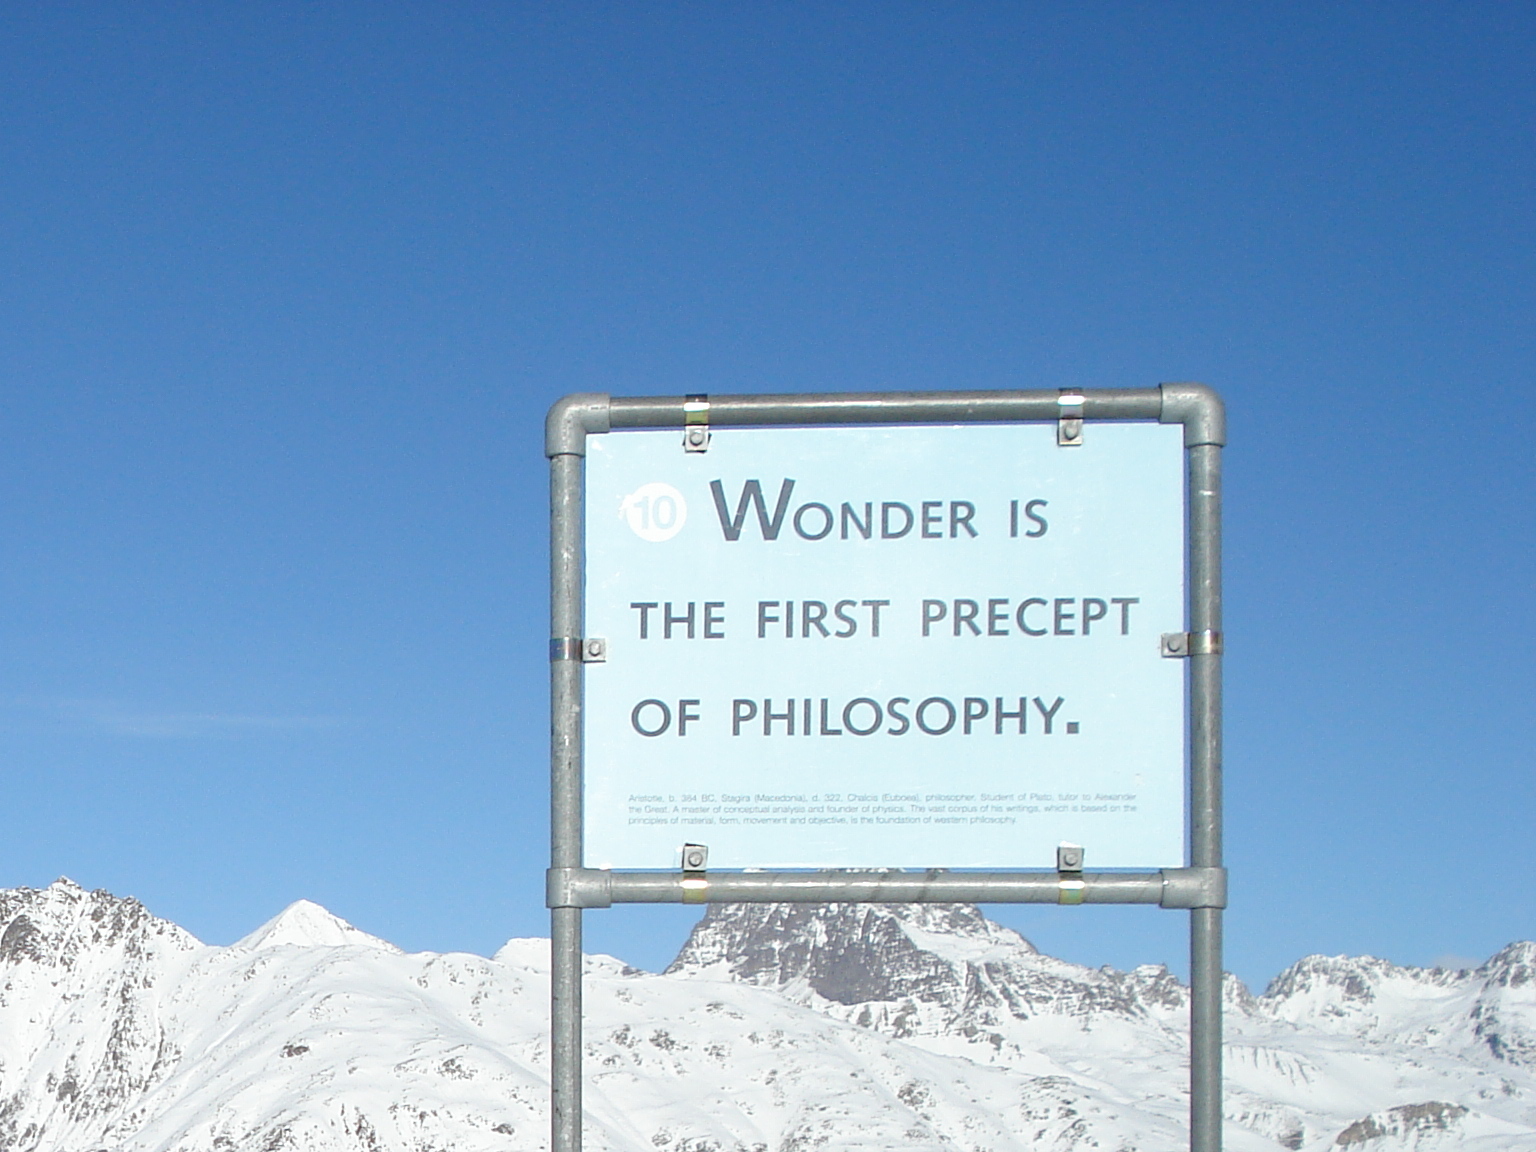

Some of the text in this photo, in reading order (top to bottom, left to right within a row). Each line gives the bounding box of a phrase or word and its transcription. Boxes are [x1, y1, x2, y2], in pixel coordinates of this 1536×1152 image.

[633, 495, 677, 530] 10
[1009, 499, 1049, 538] IS
[630, 597, 1140, 639] THE FIRST PRECEPT
[630, 696, 1080, 737] OF PHILOSOPHY.
[628, 805, 642, 813] the
[672, 805, 679, 813] A
[681, 805, 710, 813] master
[713, 805, 722, 813] of
[723, 804, 770, 815] conceptual
[772, 804, 805, 814] analysis
[808, 804, 825, 813] and
[827, 804, 858, 813] founder
[861, 804, 870, 813] of
[910, 804, 926, 813] The
[928, 804, 946, 813] vast
[948, 804, 978, 814] corpus
[980, 804, 989, 812] of
[991, 804, 1003, 812] his
[1044, 804, 1069, 812] which
[1071, 804, 1079, 812] is
[1081, 804, 1108, 812] based
[1110, 804, 1121, 812] on
[1123, 803, 1137, 812] the
[980, 793, 1014, 801] Student
[1017, 793, 1026, 801] of
[1058, 793, 1078, 801] tutor
[1082, 793, 1091, 801] to
[1094, 793, 1137, 801] Alexander
[628, 816, 668, 826] principles
[670, 816, 679, 824] of
[743, 816, 787, 824] movement
[790, 816, 806, 824] and
[851, 816, 858, 824] is
[860, 816, 874, 824] the
[876, 816, 921, 824] foundation
[923, 815, 932, 824] of
[934, 815, 967, 824] western
